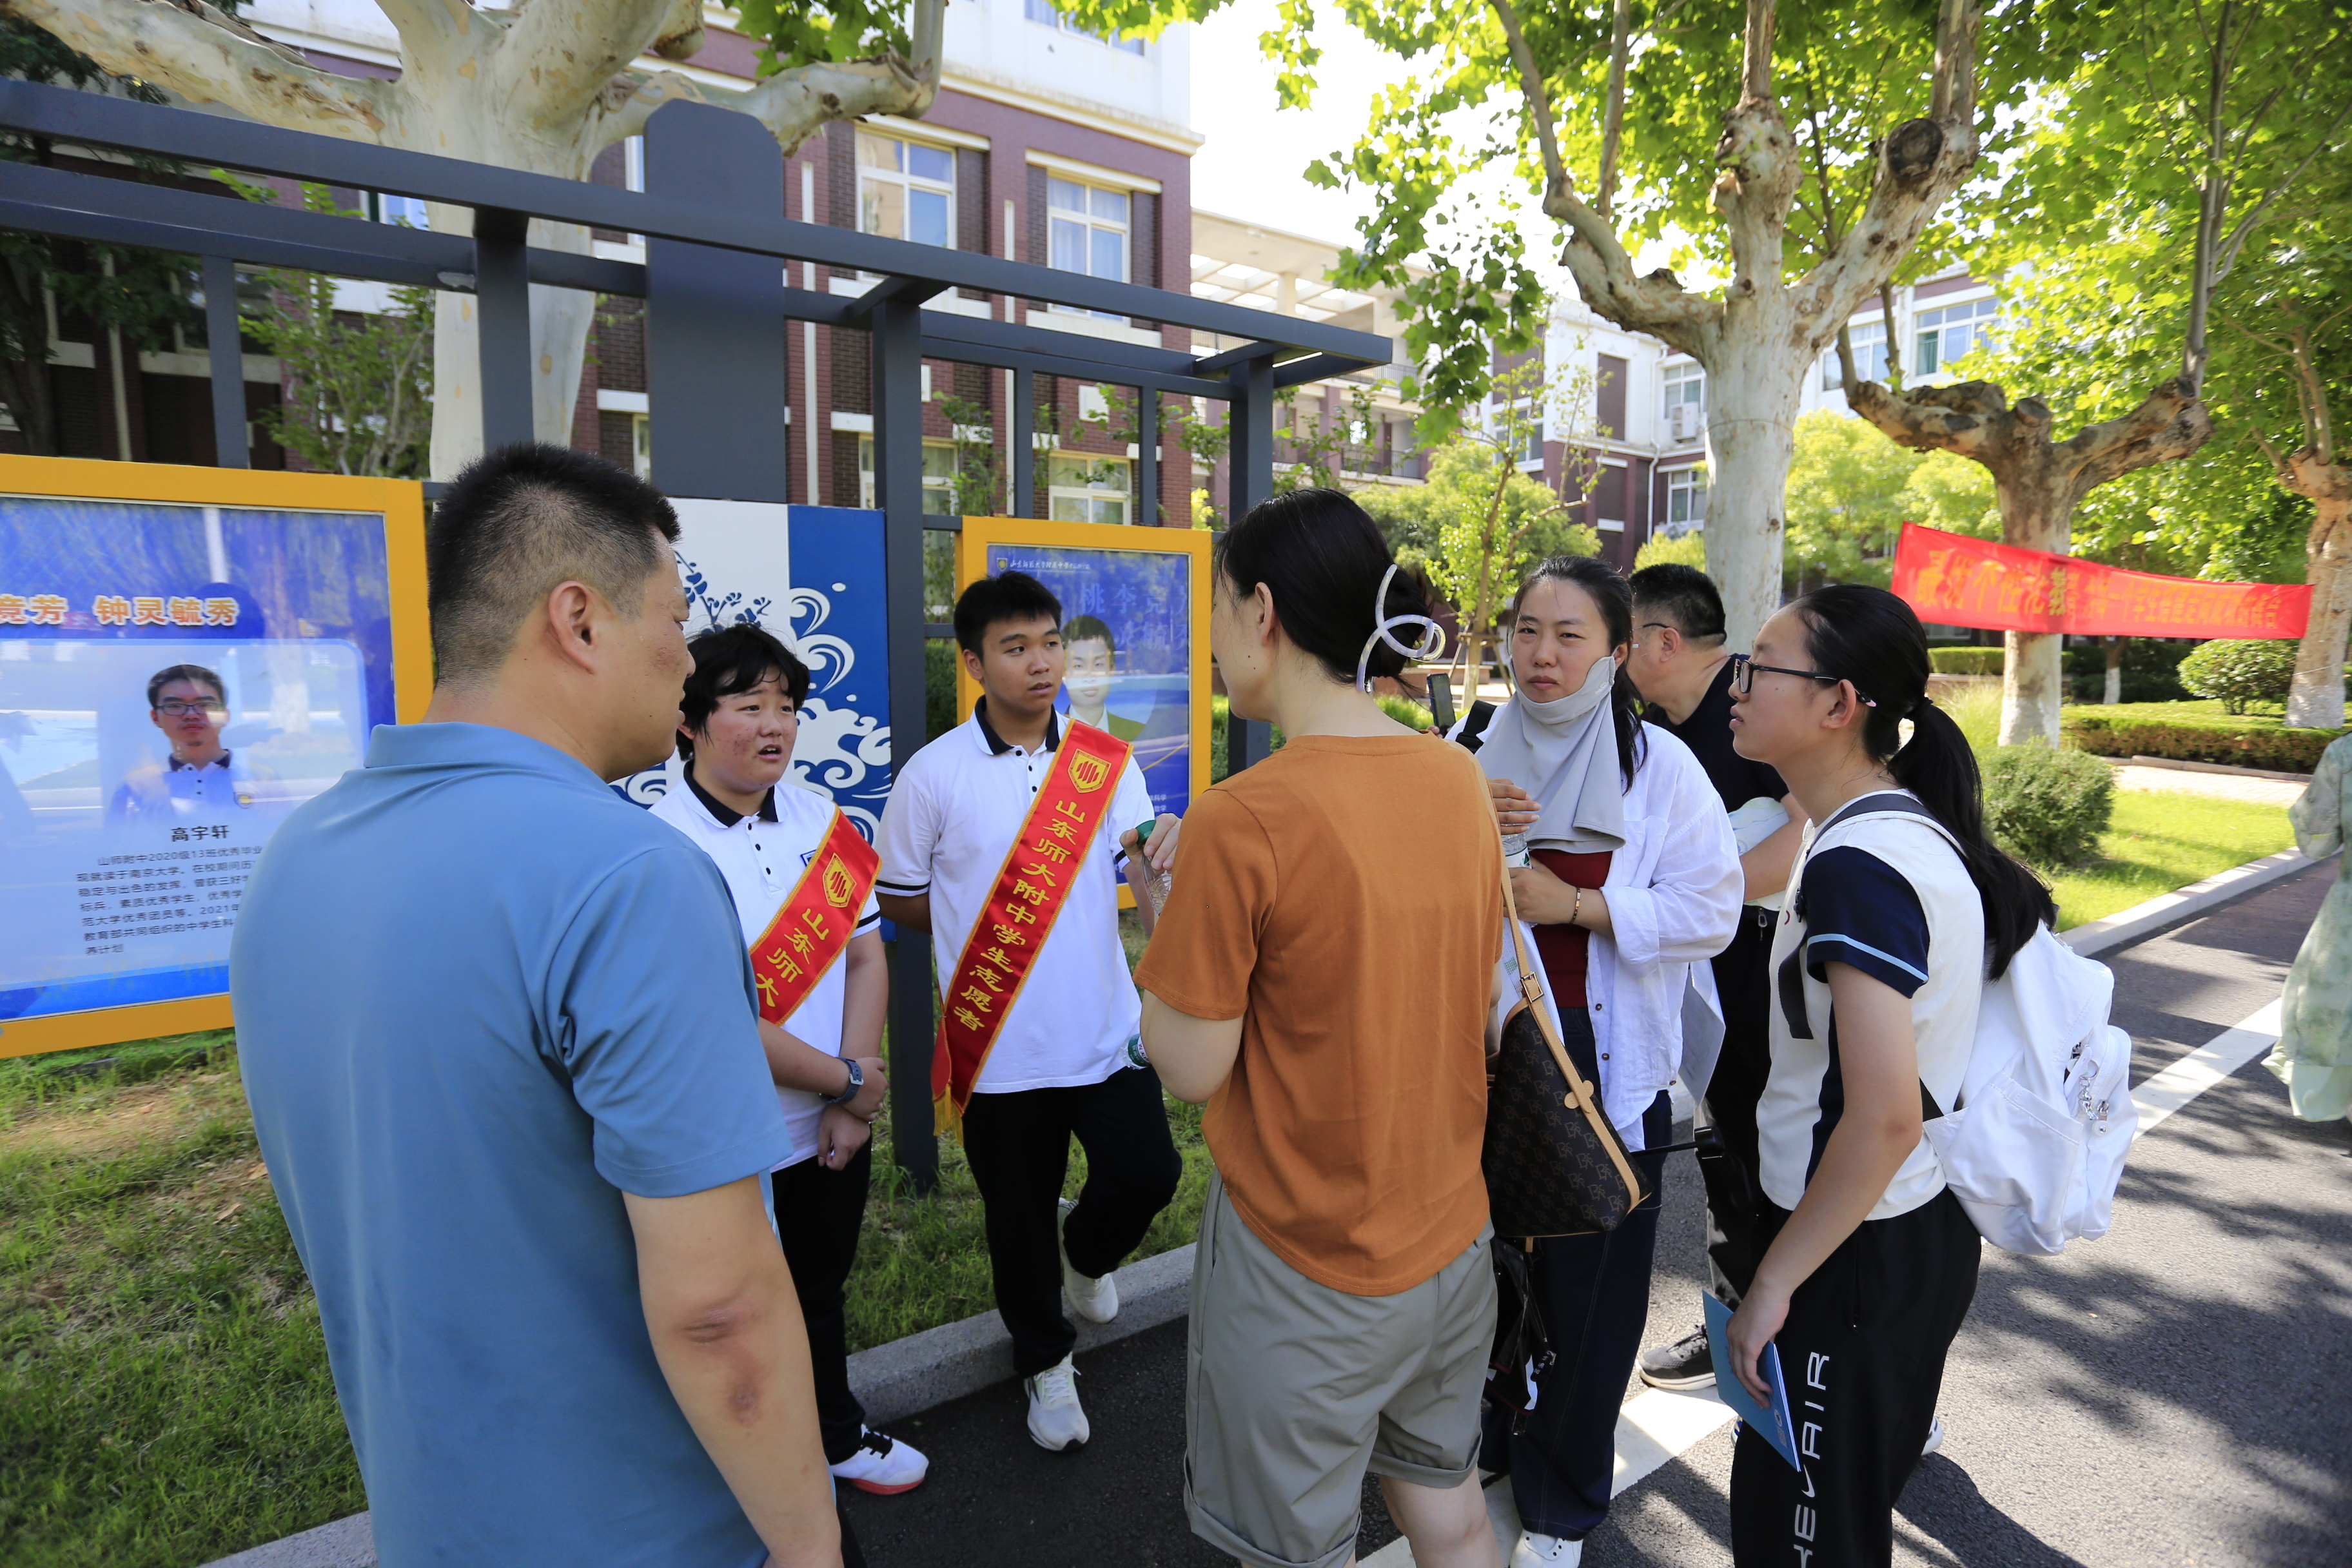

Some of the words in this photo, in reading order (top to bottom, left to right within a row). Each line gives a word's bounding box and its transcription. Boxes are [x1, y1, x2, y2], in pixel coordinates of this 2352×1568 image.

[93, 594, 239, 626] 钟灵毓秀
[171, 825, 230, 842] 高宇轩
[756, 908, 830, 1008] 山东师大
[954, 799, 1086, 1032] 山东师大附中学生志愿者
[1802, 1351, 1830, 1460] AIR
